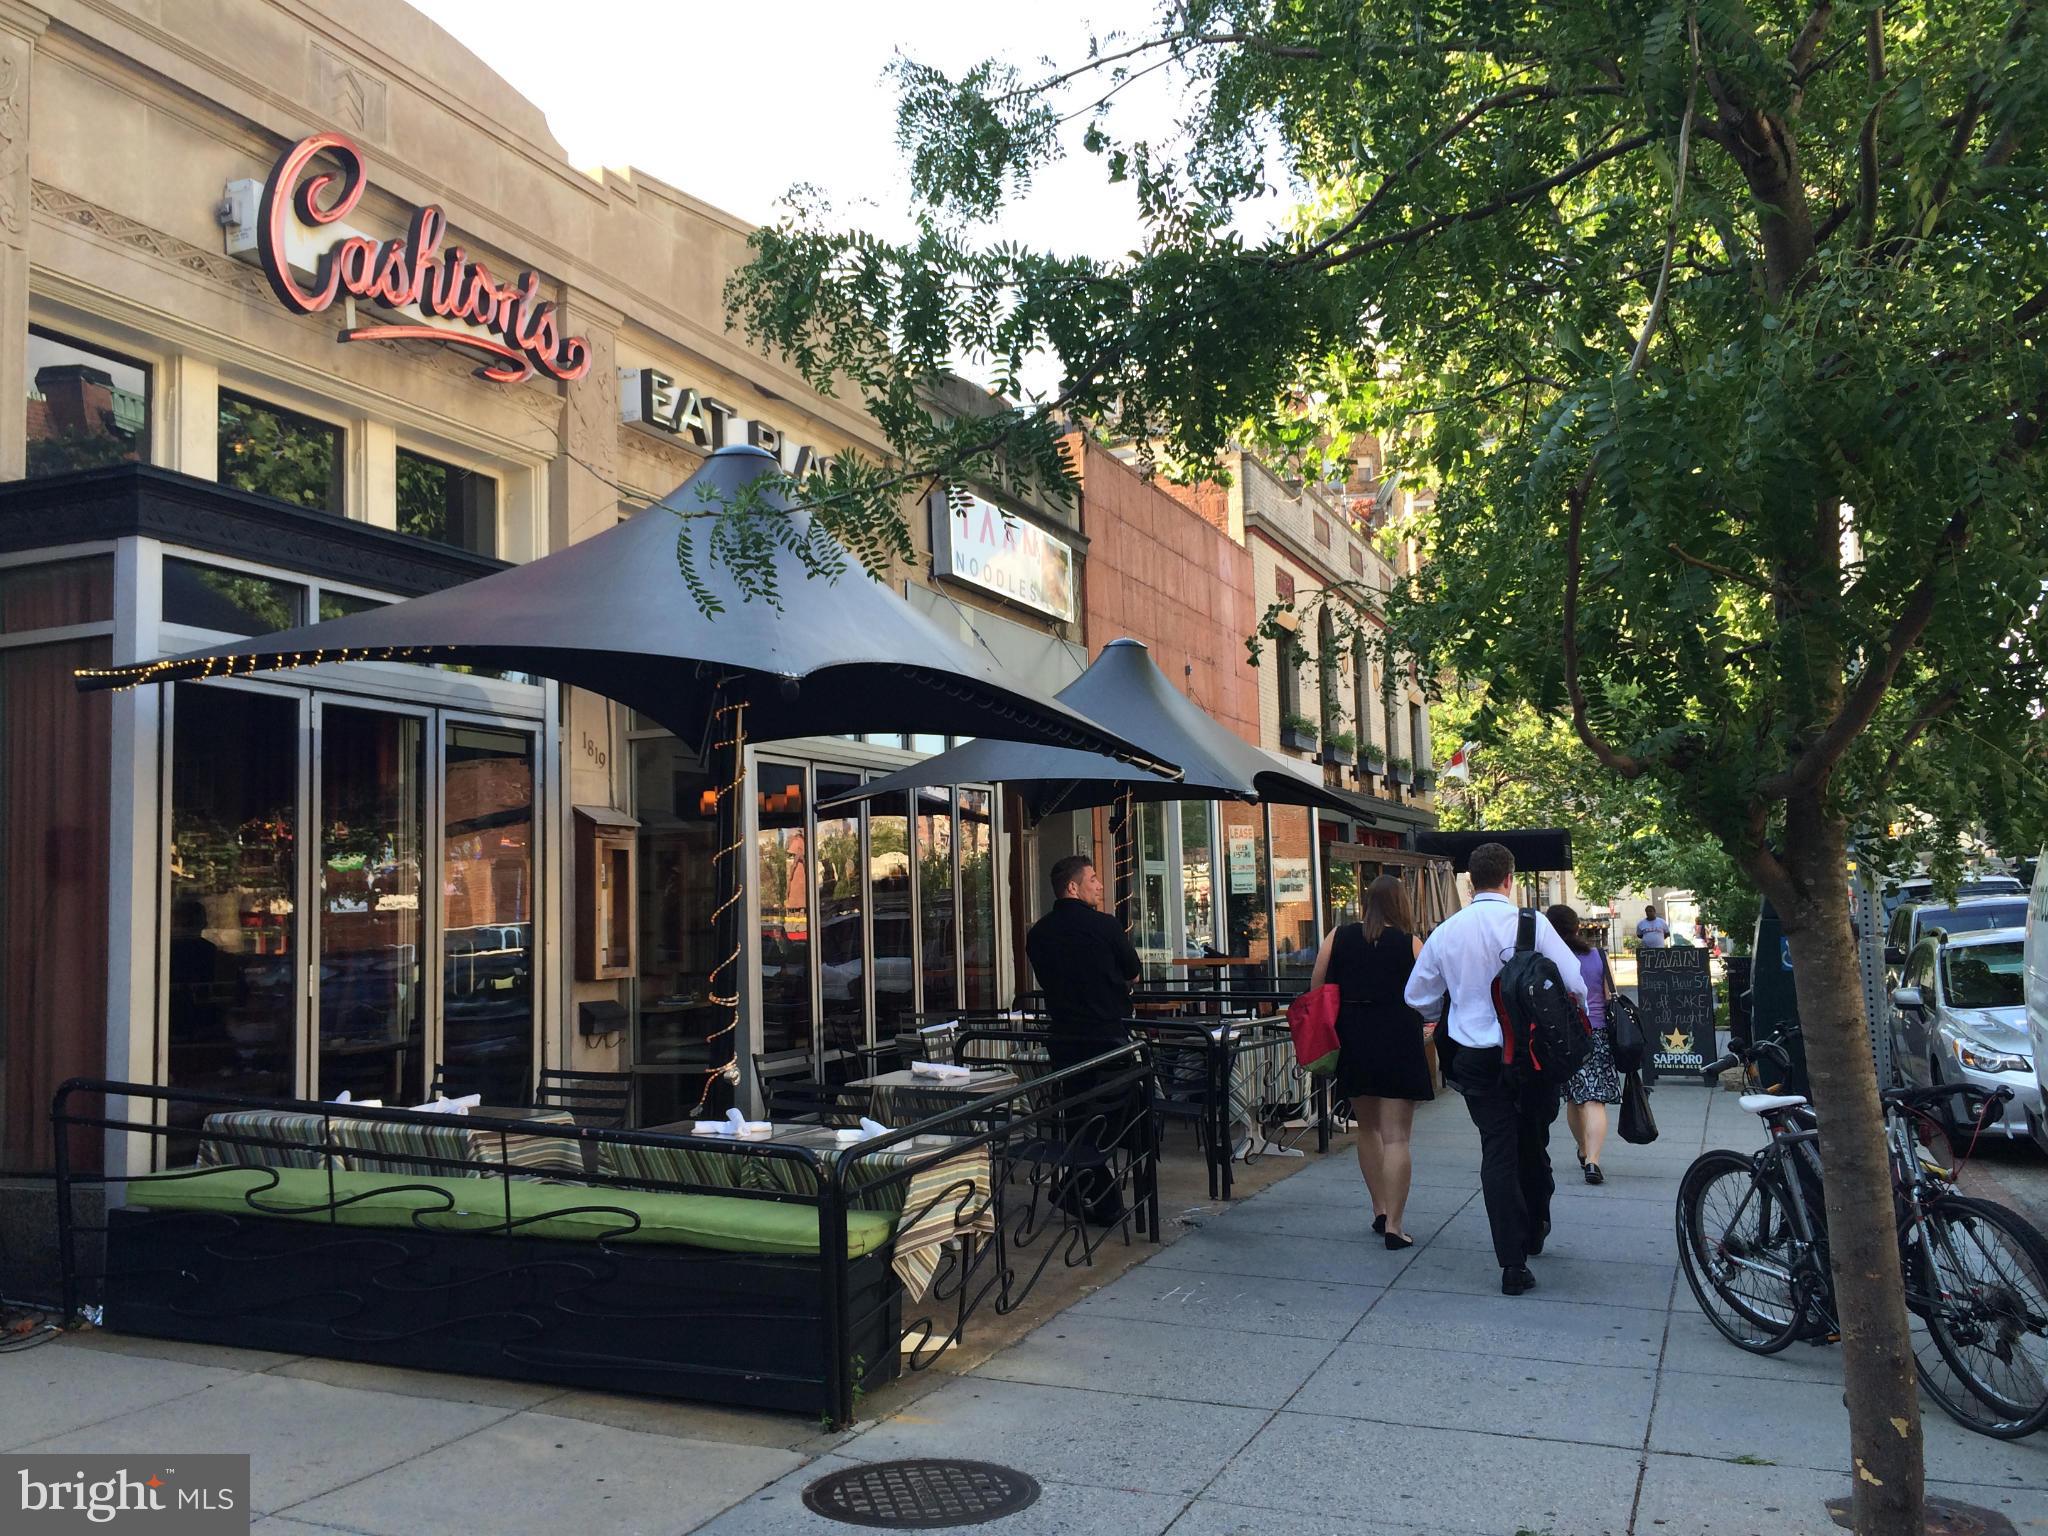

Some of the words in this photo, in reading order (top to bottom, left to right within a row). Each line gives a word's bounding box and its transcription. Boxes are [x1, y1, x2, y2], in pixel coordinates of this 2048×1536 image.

[257, 132, 592, 382] Cashion's
[641, 368, 737, 451] EAT
[955, 550, 1038, 602] NOODLES
[583, 731, 606, 769] 1819
[1230, 828, 1252, 839] LEASE
[1640, 950, 1700, 968] TAAN
[1641, 976, 1668, 993] Happy
[1671, 975, 1692, 988] Hour
[1655, 1008, 1672, 1023] all
[1653, 1053, 1703, 1065] SAPPORO
